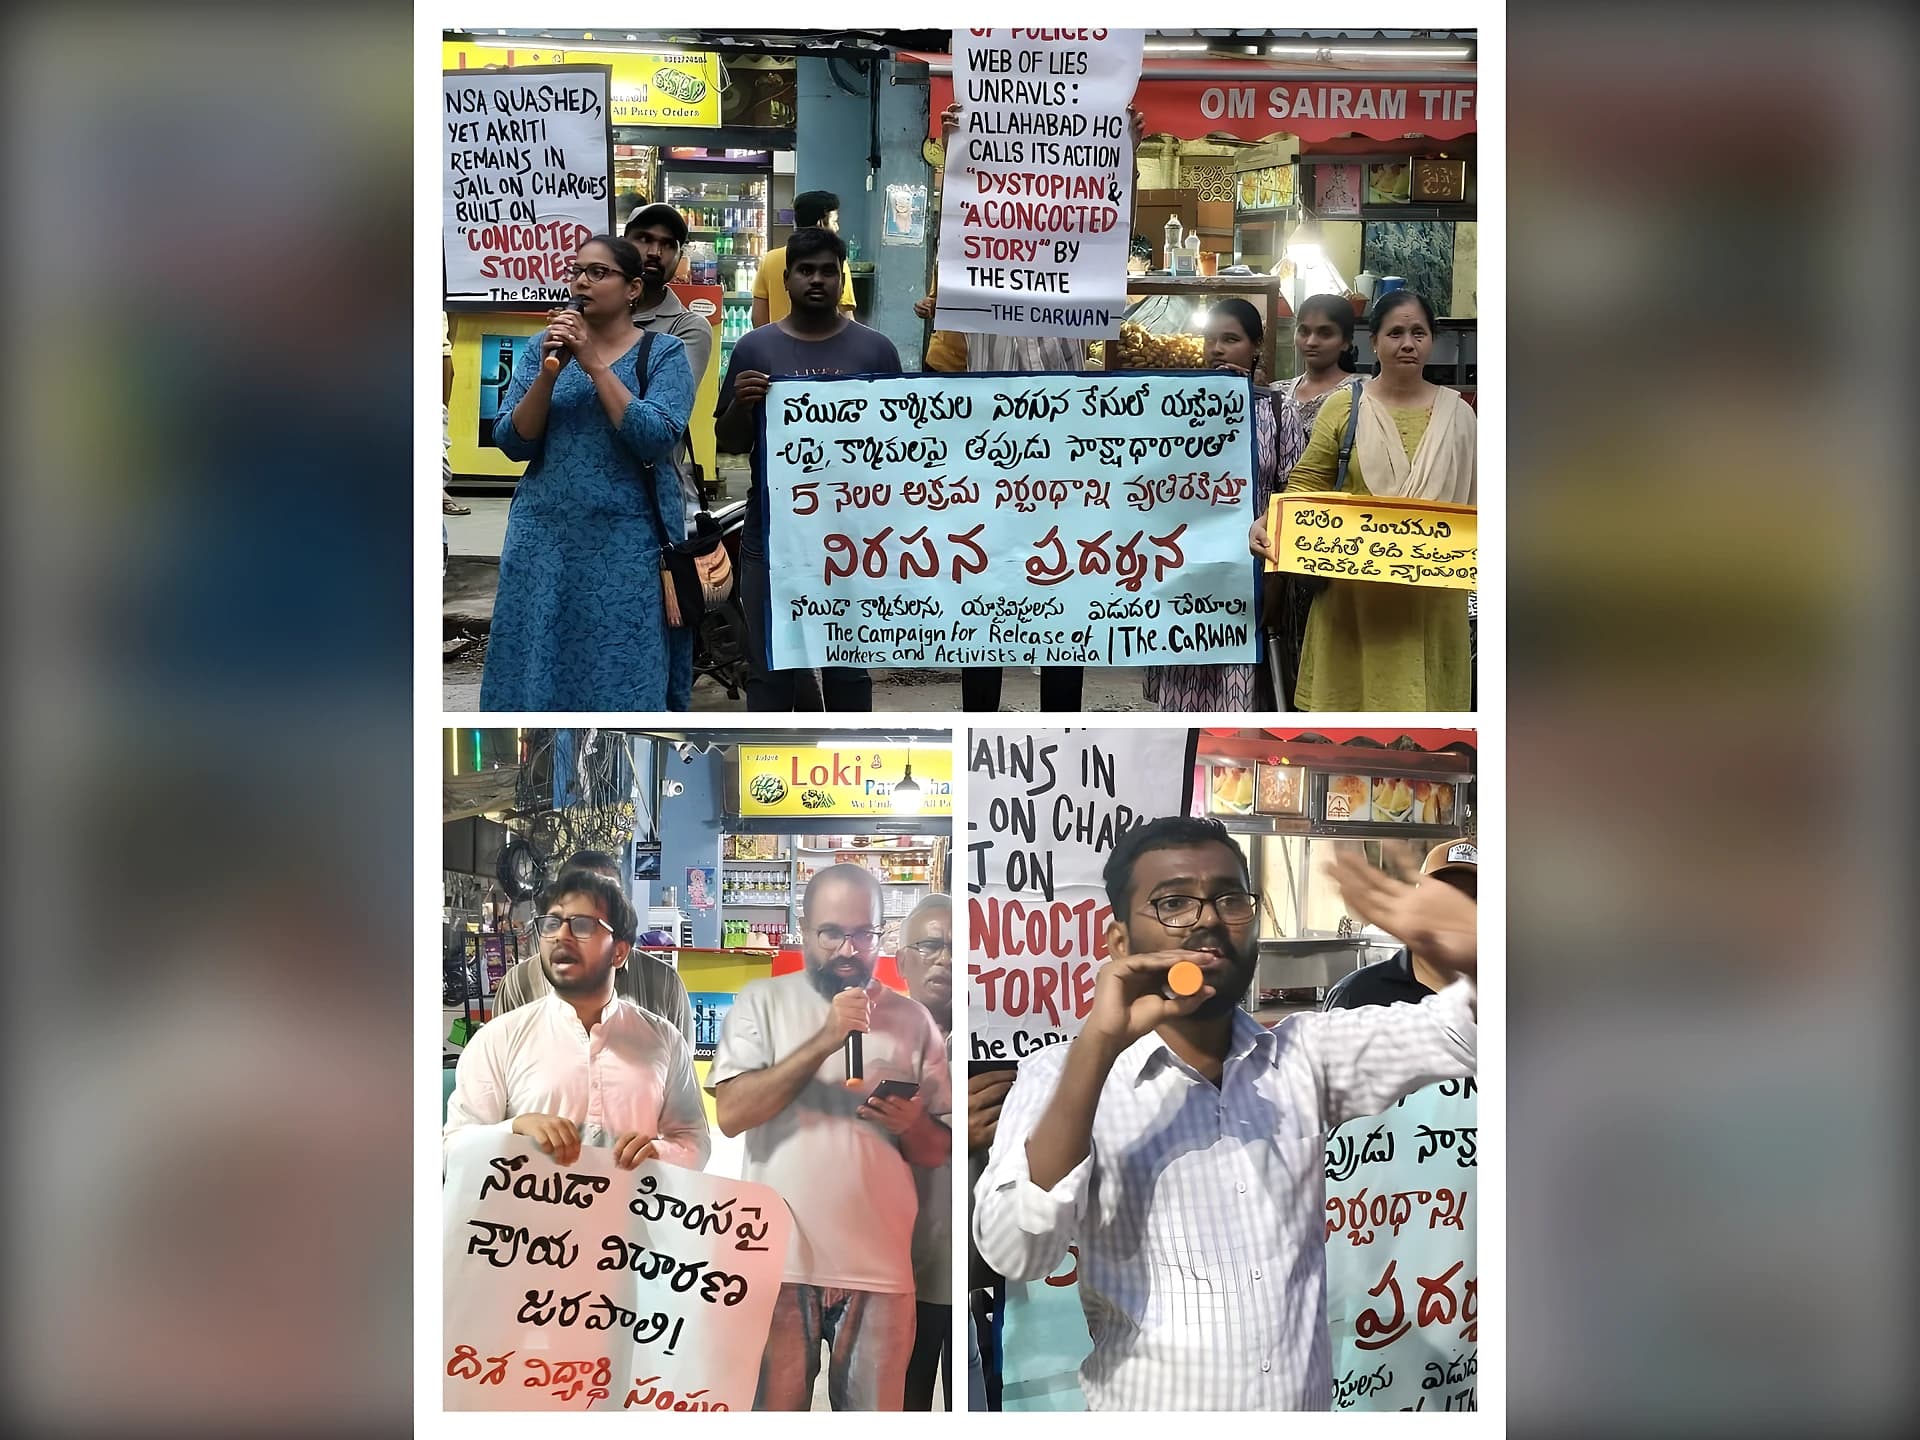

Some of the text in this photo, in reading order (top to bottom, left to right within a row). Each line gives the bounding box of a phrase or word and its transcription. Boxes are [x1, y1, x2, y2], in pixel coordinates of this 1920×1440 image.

[967, 48, 1088, 75] WEB OF LIES
[445, 87, 489, 116] NSA
[493, 84, 602, 119] QUASHED,
[1200, 87, 1255, 119] OM
[1268, 87, 1407, 119] SAIRAM
[448, 118, 546, 143] YET AKRITI
[968, 111, 1122, 139] ALLAHABAD HC
[451, 146, 566, 176] REMAINS IN
[968, 139, 1121, 167] CALLS ITS ACTION
[453, 172, 607, 200] JAIL ON CHARGES
[1108, 182, 1123, 207] &
[456, 199, 537, 225] BUILT ON
[984, 200, 1119, 234] CONCOCTED
[1054, 240, 1081, 264] BY
[489, 287, 519, 301] The
[966, 266, 1071, 294] THE STATE
[991, 304, 1109, 327] THE CARWAN
[783, 393, 868, 426] నోయిడా
[879, 391, 973, 430] కార్మికుల
[992, 388, 1071, 423] నిరసన
[1077, 384, 1150, 418] కేసులో
[834, 435, 948, 470] కార్మికులపై
[965, 428, 1051, 470] తప్పుడు
[1064, 428, 1241, 468] సాక్షాధారాలతో
[792, 482, 820, 515] 5
[827, 481, 891, 513] నెలల
[900, 475, 980, 511] అక్రమ
[823, 523, 1188, 593] నిరసన ప్రదర్శన
[1369, 541, 1404, 558] అది
[790, 594, 851, 622] నోయిడా
[1088, 598, 1160, 620] విడుదల
[824, 620, 1094, 647] The Campaign for Release of
[826, 643, 1101, 665] Workers and Activists of Noida
[791, 752, 862, 787] Loki
[1081, 744, 1115, 798] IN
[989, 796, 1036, 843] ON
[1006, 850, 1054, 902] ON
[480, 1155, 610, 1209] నోయిడా
[597, 1235, 748, 1307] విచారణ
[446, 1344, 516, 1386] దిశ
